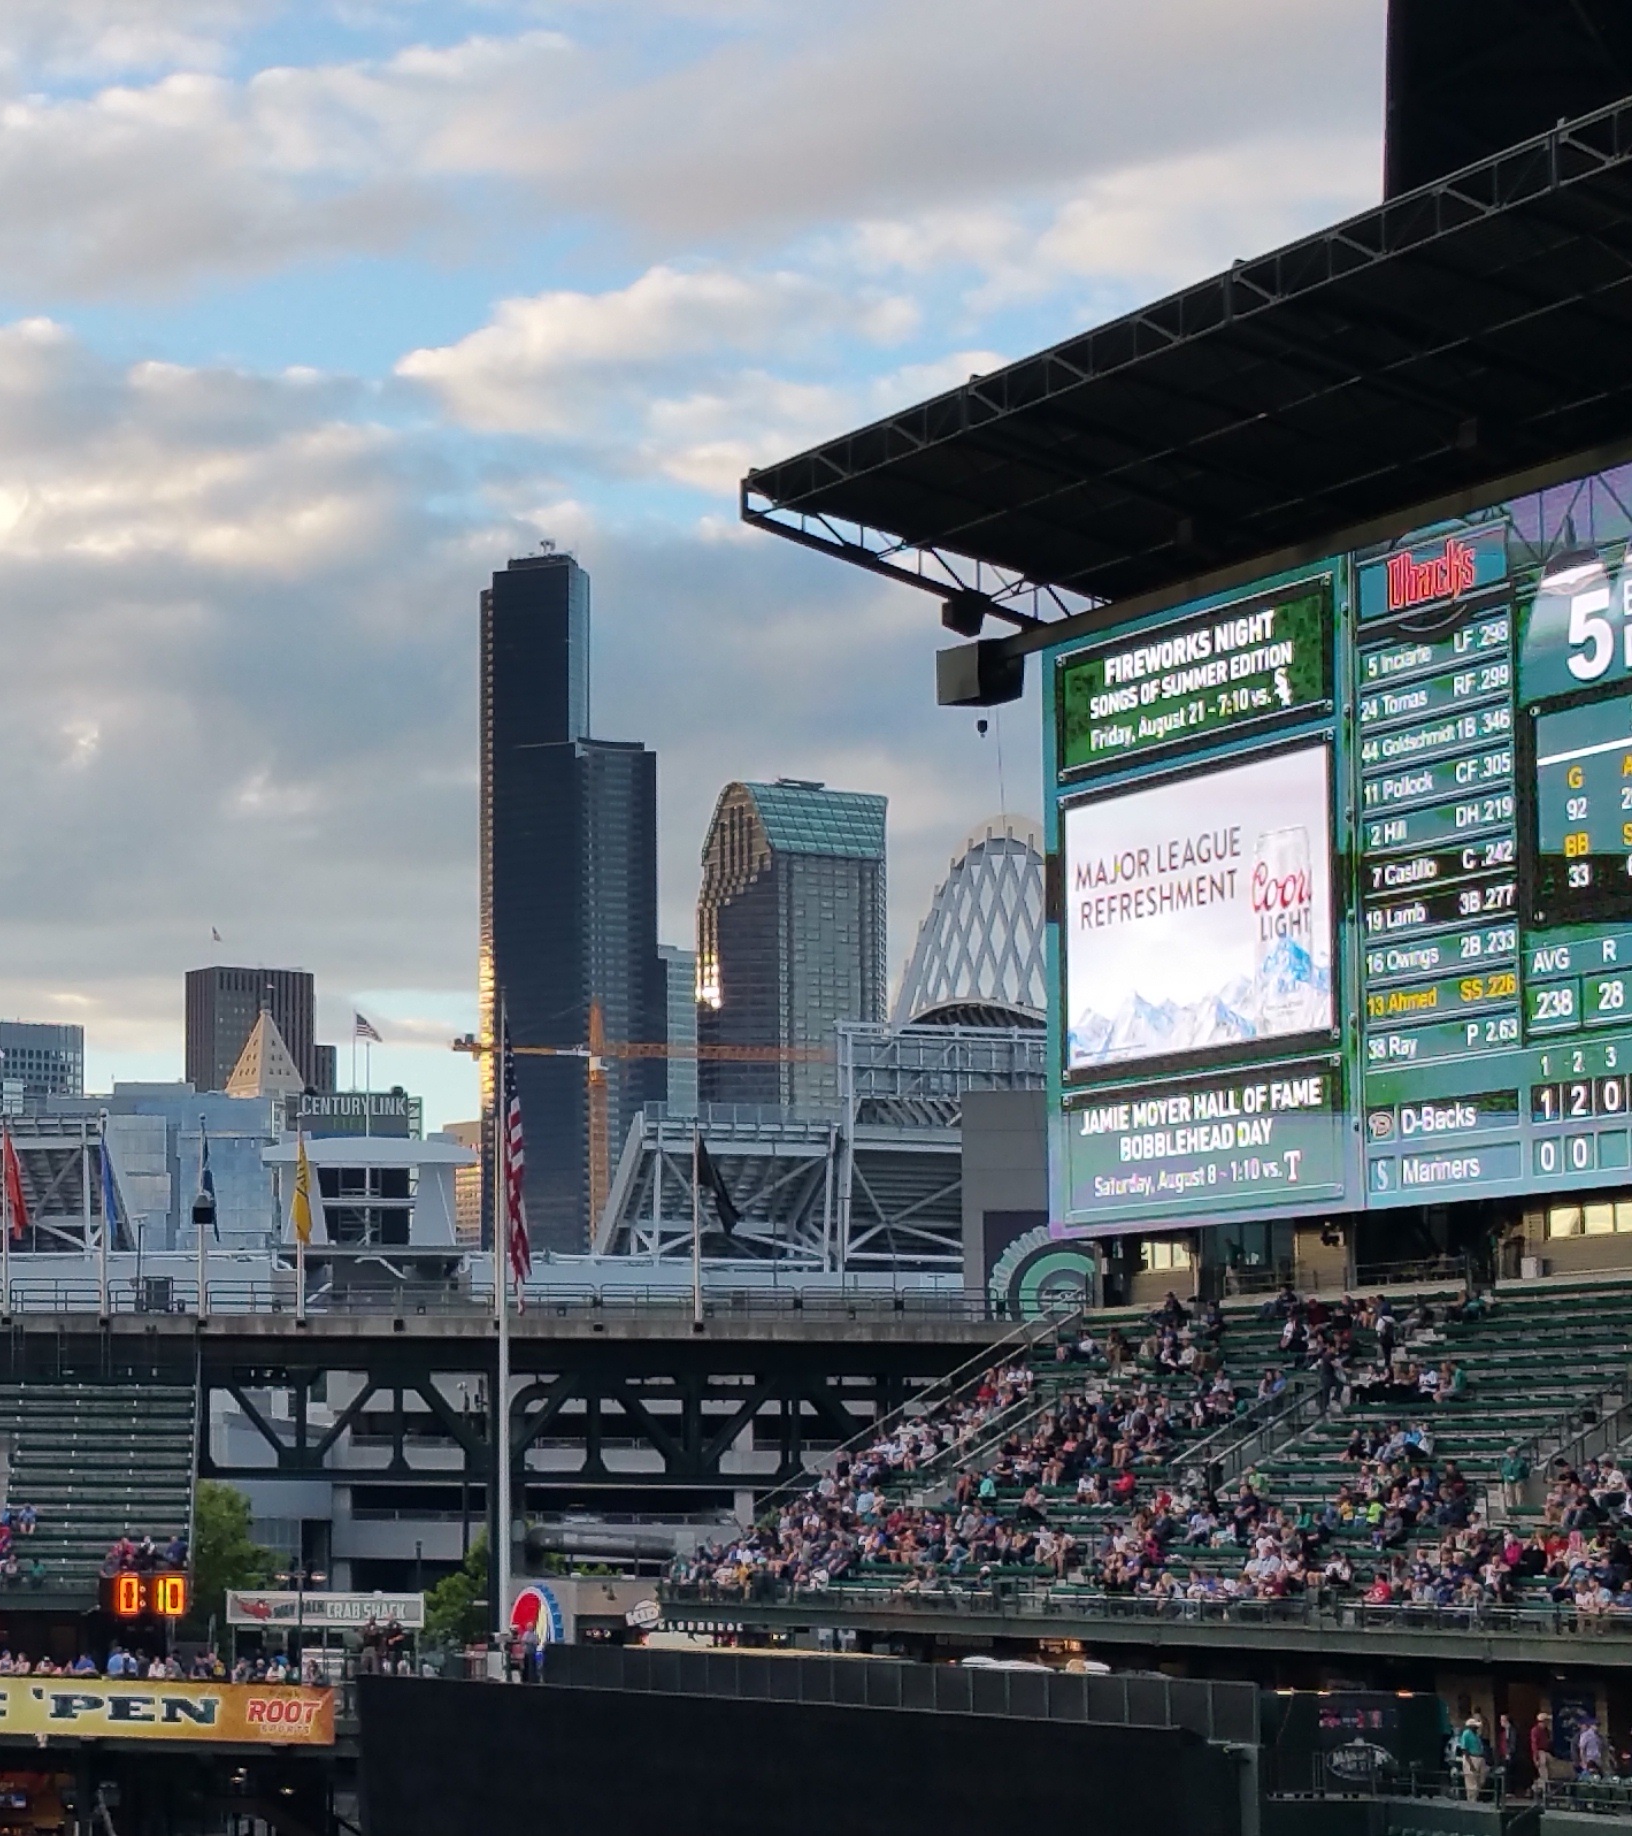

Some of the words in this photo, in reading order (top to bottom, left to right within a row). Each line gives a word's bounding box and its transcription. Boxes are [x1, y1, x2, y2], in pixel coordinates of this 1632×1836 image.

[1104, 630, 1211, 686] FIREWORKS
[1214, 610, 1276, 653] NIGHT
[1368, 655, 1378, 677] 5
[1453, 630, 1474, 653] LF
[1567, 588, 1614, 680] 5
[1090, 686, 1139, 720] SONGS
[1140, 679, 1161, 705] OF
[1161, 660, 1228, 699] SUMMER
[1230, 641, 1295, 681] EDITION
[1361, 700, 1378, 721] 24
[1381, 691, 1428, 714] Tomas
[1453, 673, 1476, 697] RF
[1477, 665, 1509, 690] .299
[1090, 723, 1136, 752] Friday,
[1139, 706, 1186, 738] August
[1188, 700, 1205, 725] 21
[1217, 688, 1249, 718] 7:10
[1249, 690, 1272, 708] vs.
[1362, 741, 1379, 761] 44
[1382, 724, 1455, 757] Goldschmidt
[1456, 717, 1476, 739] 1B
[1478, 709, 1510, 736] .346
[1364, 783, 1378, 805] 11
[1383, 772, 1434, 800] Pollock
[1455, 760, 1478, 784] CF
[1479, 752, 1511, 779] .305
[1568, 765, 1584, 789] G
[1370, 826, 1381, 846] 2
[1384, 820, 1407, 844] Hill
[1455, 803, 1479, 828] DH
[1566, 796, 1588, 821] 92
[1075, 848, 1150, 891] MAJOR
[1156, 826, 1241, 873] LEAGUE
[1384, 858, 1437, 885] Castillo
[1462, 849, 1477, 869] C
[1481, 840, 1513, 867] .242
[1565, 832, 1589, 857] BB
[1568, 863, 1590, 888] 33
[1081, 868, 1238, 931] REFRESHMENT
[1366, 910, 1383, 932] 19
[1386, 902, 1426, 929] Lamb
[1460, 891, 1481, 915] 3B
[1482, 884, 1515, 911] .277
[1260, 908, 1311, 942] LIGHT
[1366, 953, 1384, 974] 16
[1387, 947, 1440, 970] Owings
[1460, 936, 1481, 959] 2B
[1532, 948, 1570, 973] AVG
[1602, 940, 1617, 962] R
[1367, 996, 1384, 1017] 13
[1388, 987, 1437, 1012] Ahmed
[1460, 978, 1483, 1002] SS
[1531, 989, 1573, 1019] .238
[1598, 981, 1624, 1010] 28
[1389, 1036, 1418, 1059] Ray
[1467, 1025, 1478, 1046] P
[1486, 1019, 1517, 1042] 2.63
[1573, 1051, 1585, 1072] 2
[1606, 1046, 1617, 1068] 3
[301, 1095, 406, 1116] CENTURYLINK
[1080, 1104, 1130, 1136] JAMIE
[1133, 1096, 1191, 1129] MOYER
[1193, 1089, 1240, 1121] HALL
[1243, 1085, 1267, 1114] OF
[1270, 1077, 1323, 1110] FAME
[1402, 1102, 1477, 1134] D-Backs
[1541, 1088, 1552, 1120] 1
[1571, 1085, 1587, 1116] 2
[1604, 1081, 1619, 1111] 0
[1120, 1122, 1235, 1162] BOBBLEHEAD
[1237, 1118, 1273, 1147] DAY
[1094, 1175, 1154, 1199] Saturday,
[1157, 1166, 1205, 1193] August
[1207, 1164, 1217, 1185] 8
[1231, 1158, 1260, 1182] 1:10
[1262, 1161, 1283, 1179] vs.
[1284, 1150, 1302, 1183] T
[1403, 1156, 1480, 1184] Mariners
[1540, 1140, 1555, 1171] 0
[1572, 1138, 1587, 1168] 0
[119, 1577, 186, 1615] 0:10
[326, 1602, 361, 1620] CRAB
[364, 1602, 407, 1620] SHACK
[31, 1687, 220, 1724] 'PEN
[247, 1698, 322, 1723] ROOT
